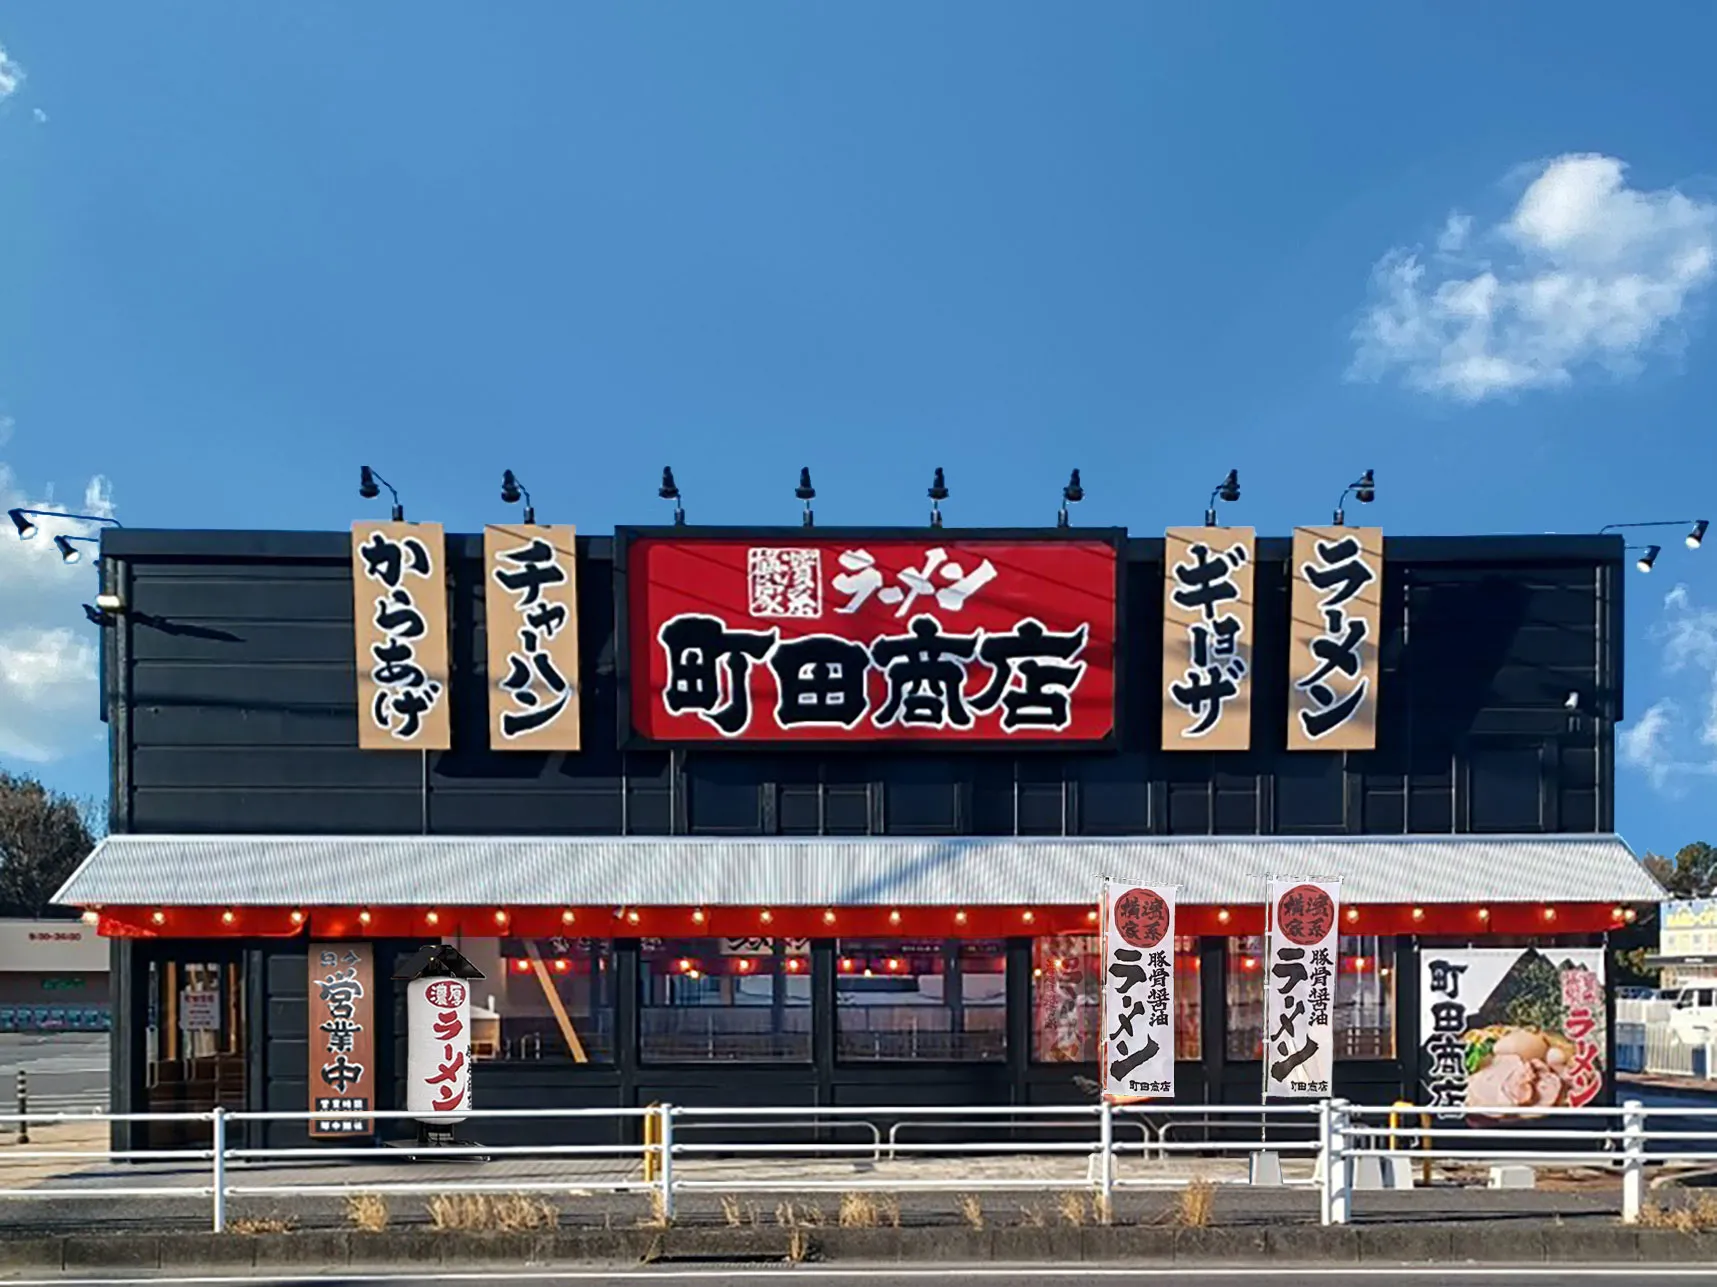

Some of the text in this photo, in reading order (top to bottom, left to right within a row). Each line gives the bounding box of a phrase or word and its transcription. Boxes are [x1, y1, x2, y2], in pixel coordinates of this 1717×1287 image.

[358, 531, 441, 740] からあげ
[495, 540, 571, 736] チャーハン
[832, 547, 998, 617] ラーメン
[1170, 543, 1248, 738] ギョーザ
[1295, 536, 1377, 741] ラーメン
[657, 613, 1090, 737] 町田商店
[313, 967, 364, 1094] 営業中
[1108, 948, 1160, 1081] ラーメン
[1147, 949, 1172, 1027] 豚骨醤油
[1271, 948, 1318, 1082] ラーメン
[1308, 949, 1334, 1027] 豚骨醤油
[425, 1011, 465, 1111] ラーメン
[1129, 1080, 1171, 1092] 町田商店
[1564, 1006, 1602, 1107] ラーメン
